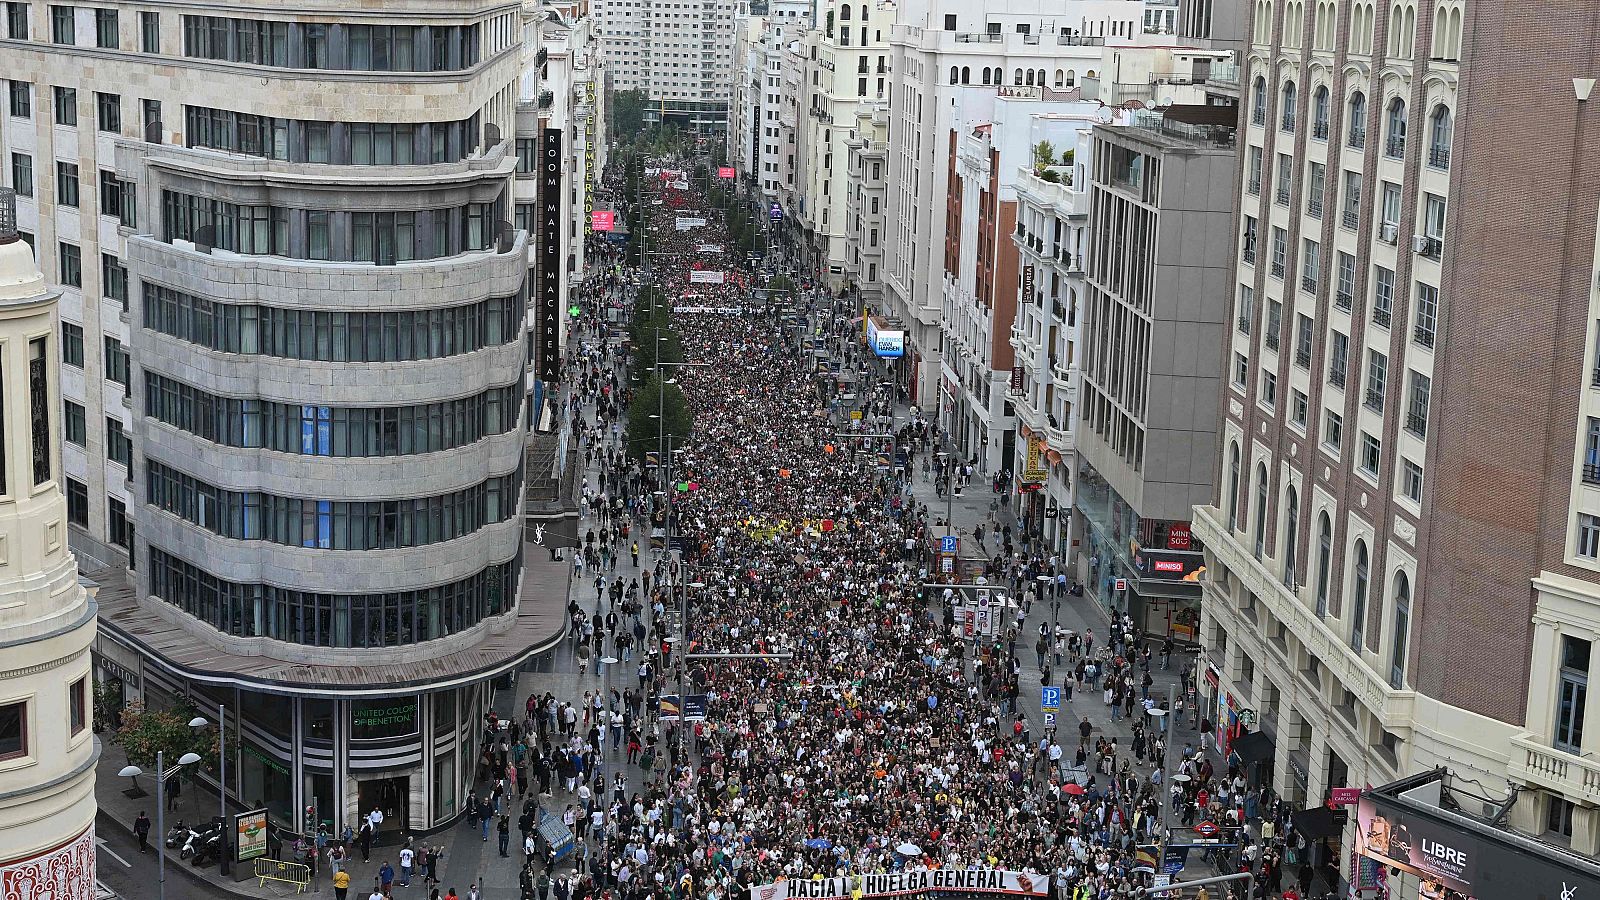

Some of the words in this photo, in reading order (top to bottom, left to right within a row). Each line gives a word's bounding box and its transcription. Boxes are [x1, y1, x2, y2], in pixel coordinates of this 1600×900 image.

[586, 81, 595, 135] HOTEL
[547, 135, 556, 186] ROOM
[584, 141, 594, 235] EMPERADOR
[547, 206, 556, 254] MATE
[546, 271, 555, 376] MACARENA
[945, 538, 953, 550] P
[1156, 562, 1181, 570] MINISO
[101, 657, 136, 686] CAPITOL
[353, 708, 385, 718] UNITED
[386, 703, 418, 716] COLORS
[1045, 689, 1058, 705] P
[353, 718, 367, 726] OF
[1045, 714, 1054, 724] P
[1422, 838, 1467, 867] LIBRE
[787, 878, 836, 897] HACIA
[866, 871, 928, 893] HUELGA
[933, 870, 1007, 889] GENERAL
